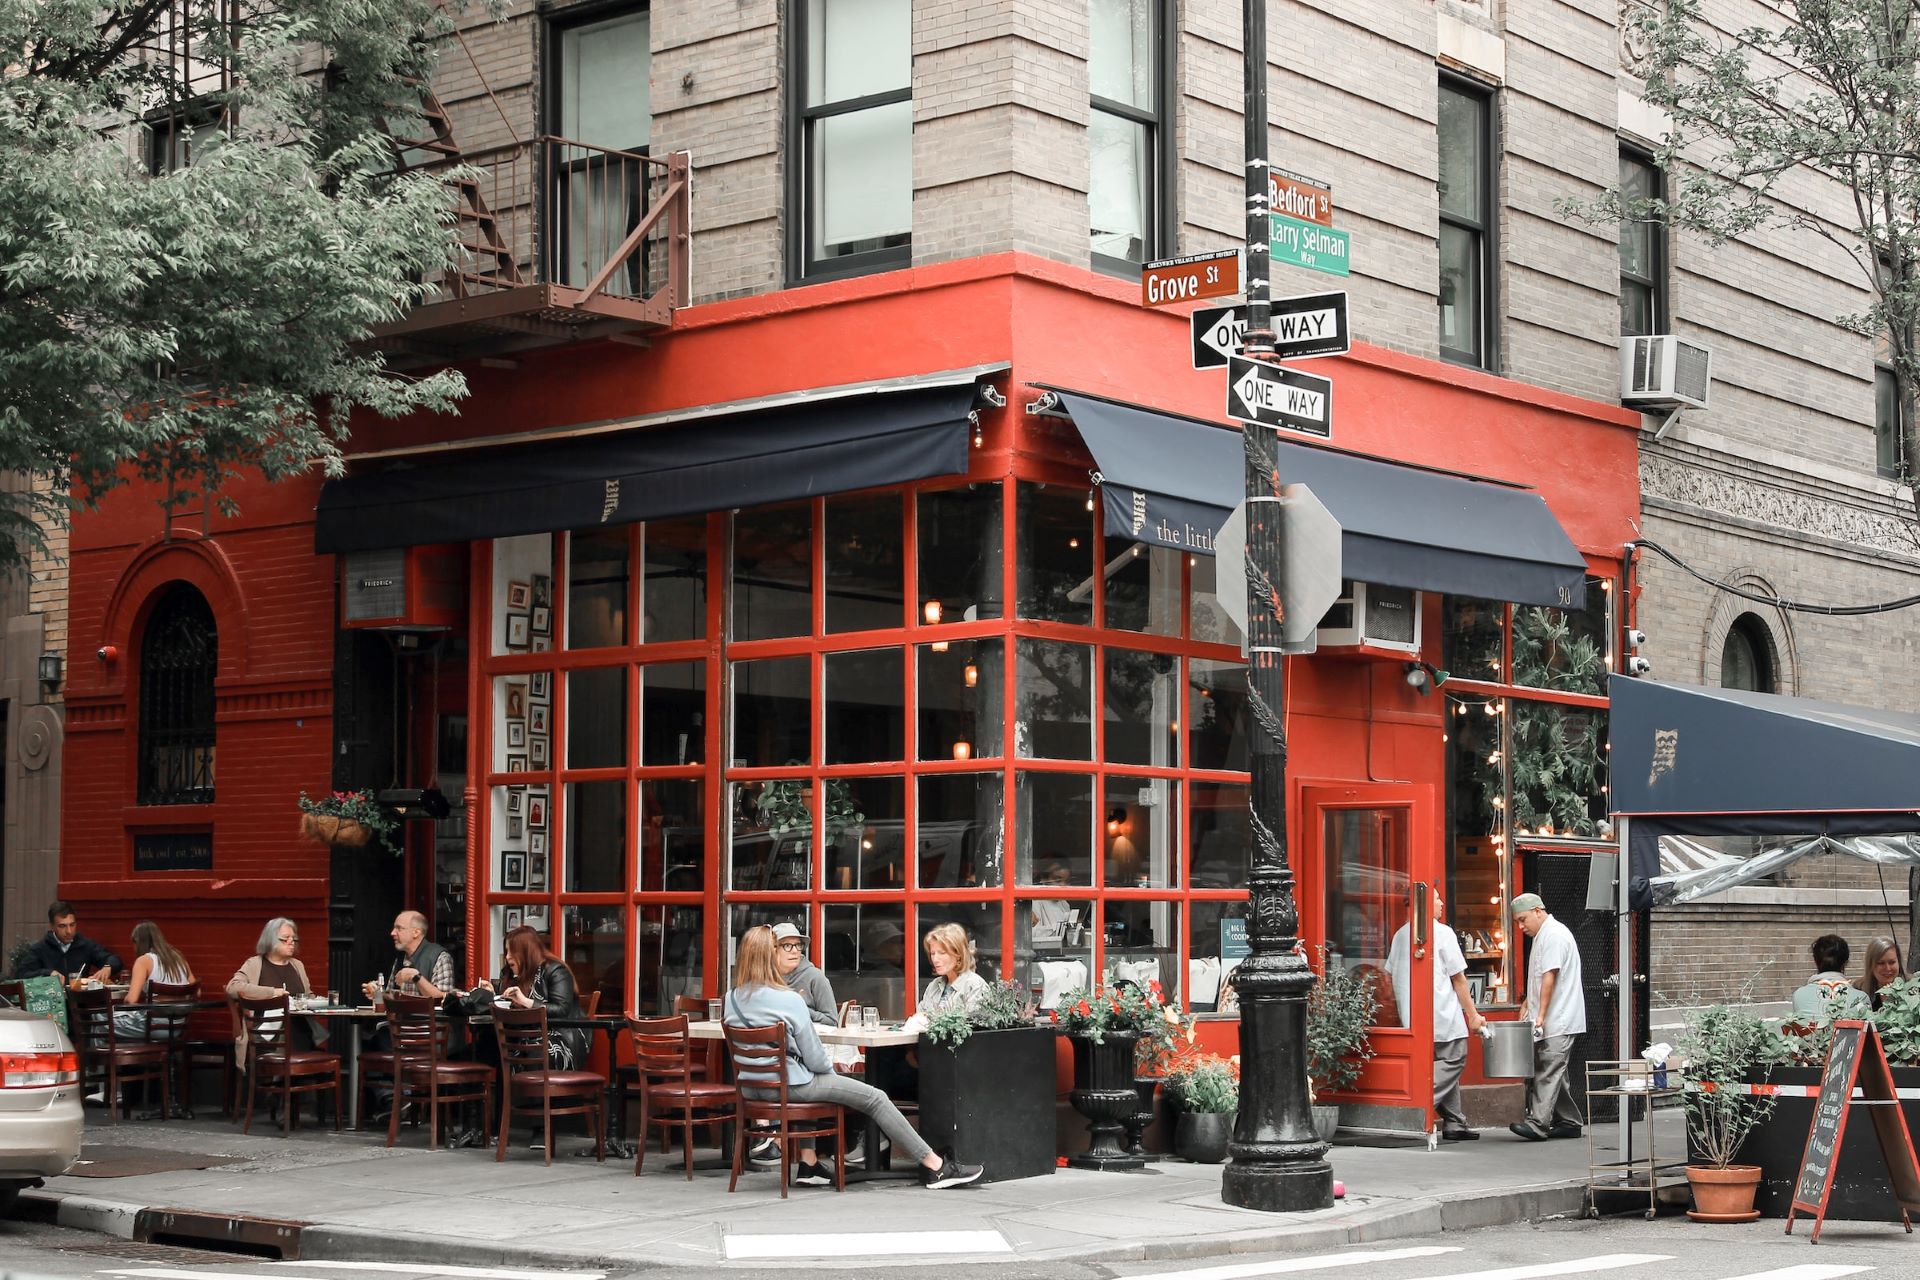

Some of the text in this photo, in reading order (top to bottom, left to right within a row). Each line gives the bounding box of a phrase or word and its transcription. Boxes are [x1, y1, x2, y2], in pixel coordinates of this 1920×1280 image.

[1270, 179, 1329, 219] Bedford St
[1271, 218, 1345, 258] Larry Selman
[1300, 250, 1316, 268] Way
[1147, 265, 1219, 303] Grove St
[1217, 313, 1326, 347] ON WAY
[1244, 379, 1318, 416] ONE WAY
[1156, 518, 1181, 544] the
[1558, 586, 1571, 605] 90
